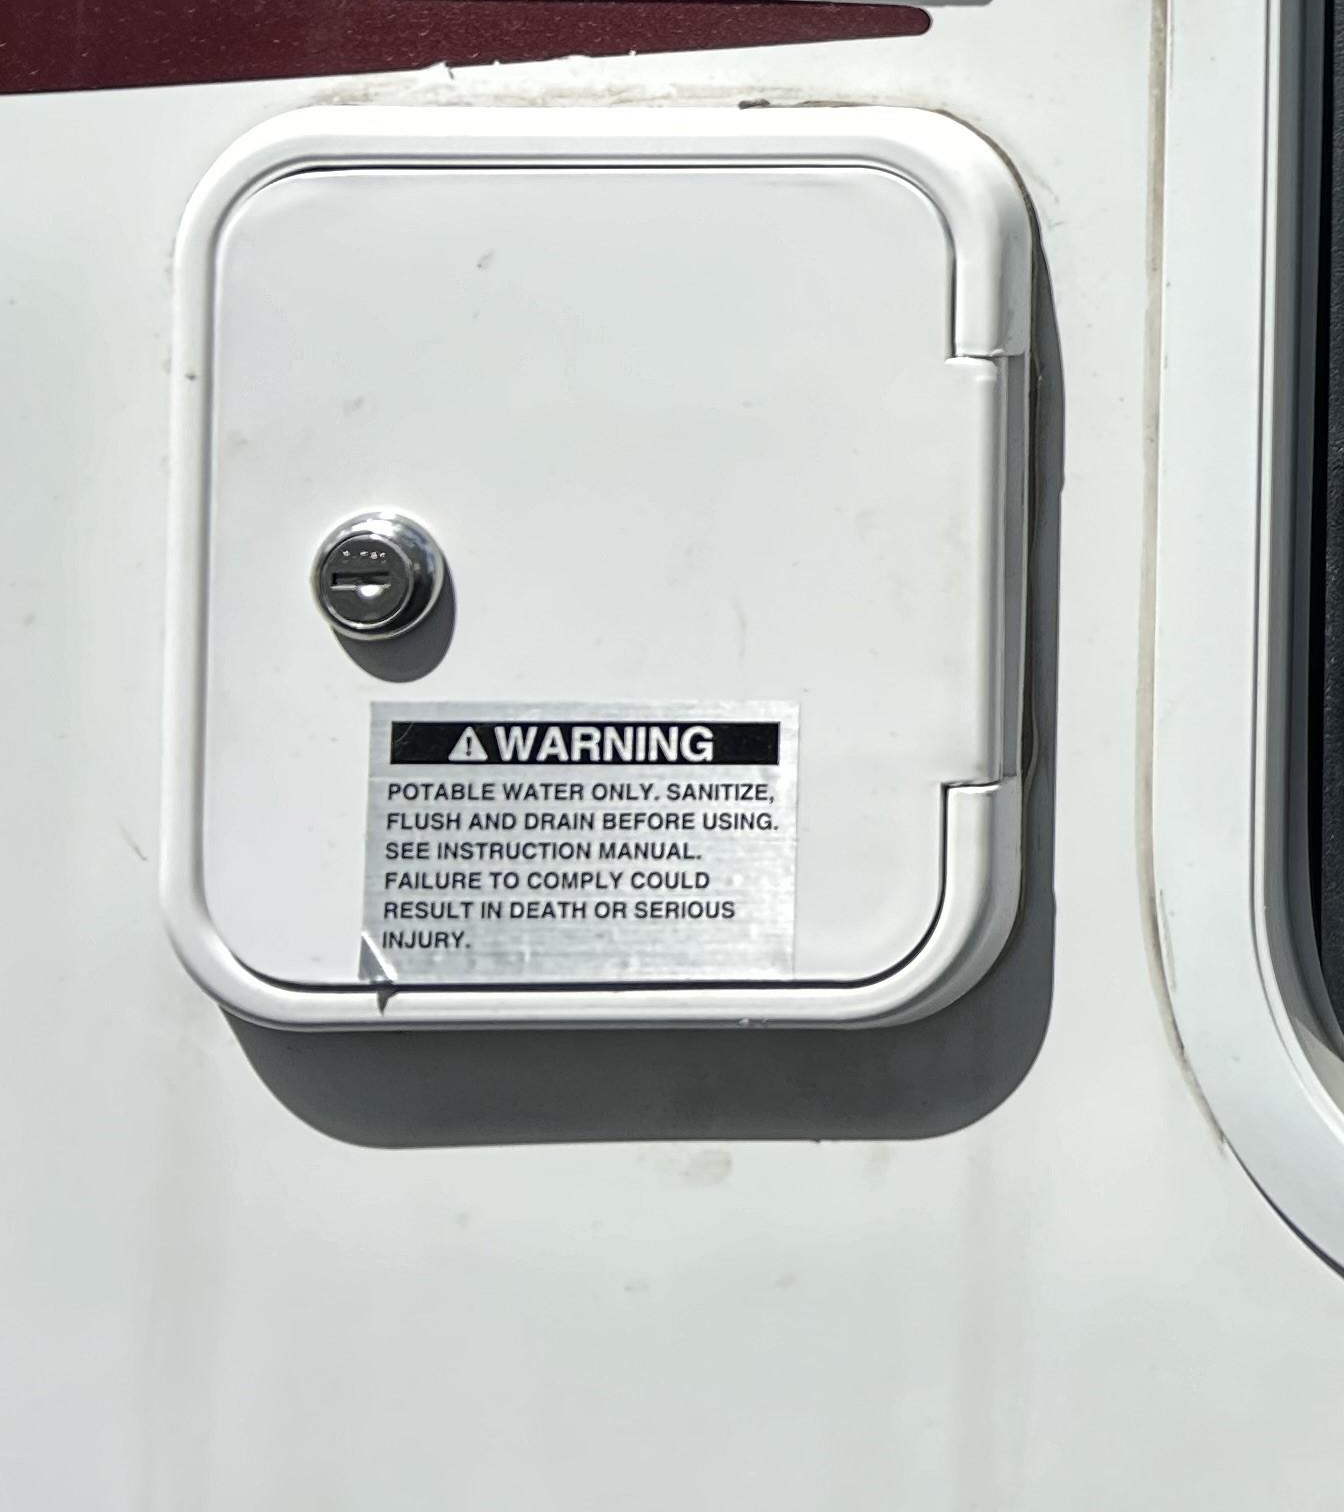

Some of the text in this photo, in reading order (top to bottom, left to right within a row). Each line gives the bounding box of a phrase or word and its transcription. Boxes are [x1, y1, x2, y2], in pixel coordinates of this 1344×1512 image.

[495, 726, 714, 763] WARNING
[388, 783, 775, 805] POTABLE WATER ONLY. SANITIZE,
[386, 812, 780, 831] FLUSH AND DRAIN BEFORE USING.
[385, 842, 703, 860] SEE INSTRUCTION MANUAL.
[385, 871, 711, 890] FAILURE TO COMPLY COULD
[384, 901, 736, 920] RESULT IN DEATH OR SERIOUS
[382, 931, 472, 950] INJURY.
